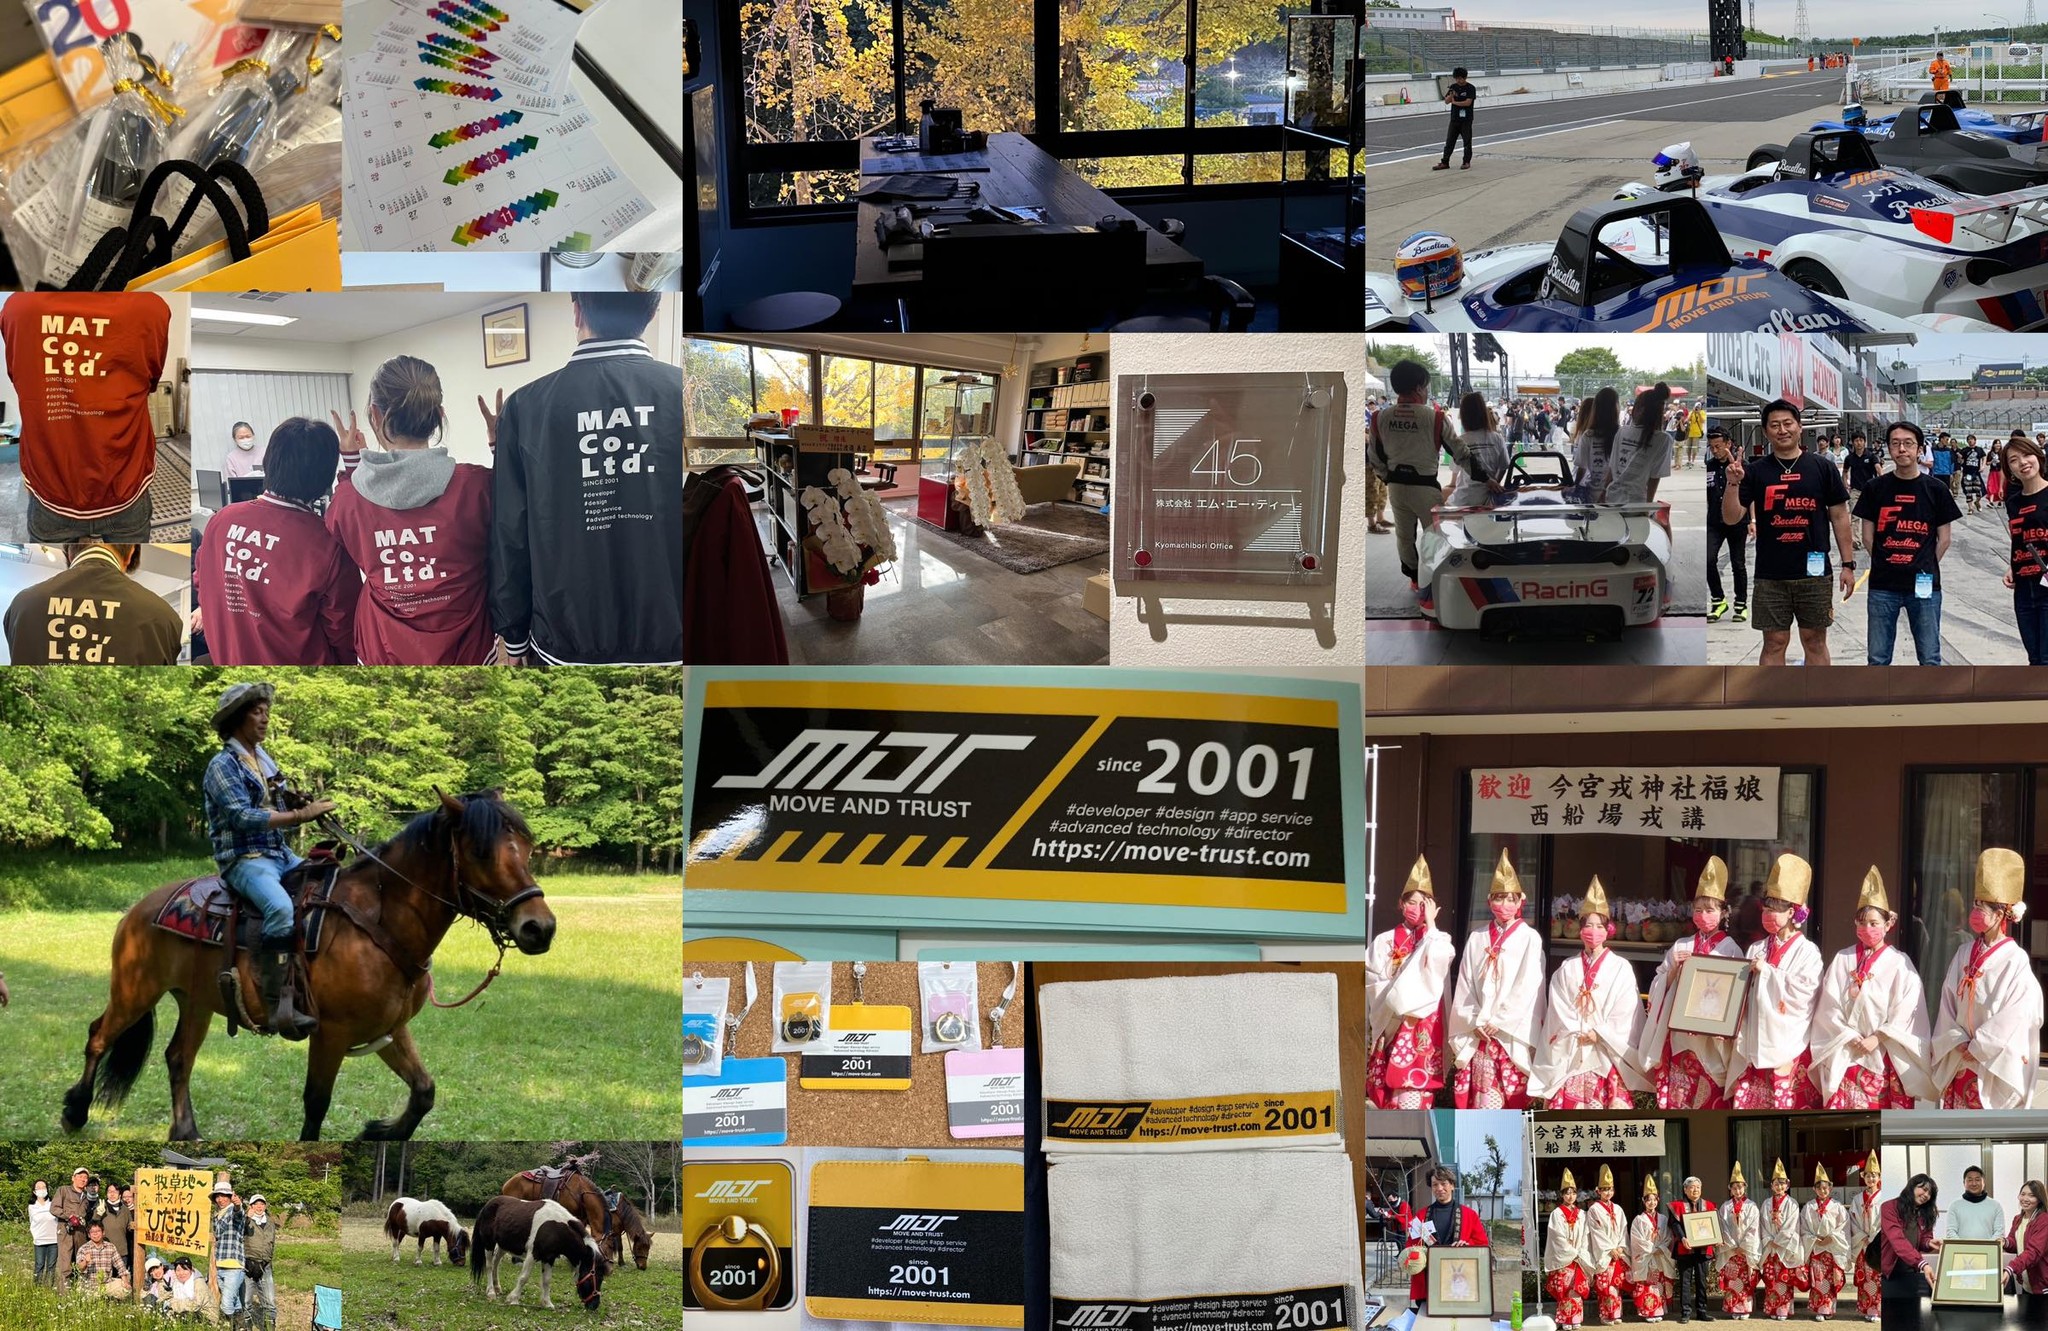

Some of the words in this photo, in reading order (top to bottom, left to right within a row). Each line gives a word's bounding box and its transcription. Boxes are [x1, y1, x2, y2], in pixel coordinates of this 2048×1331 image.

[473, 124, 481, 133] 9
[485, 153, 500, 166] 10
[506, 170, 515, 178] 30
[566, 180, 576, 189] 12
[408, 209, 417, 218] 27
[501, 210, 514, 223] 11
[373, 223, 383, 231] 26
[499, 233, 507, 242] 27
[1412, 241, 1450, 257] Bacallan
[1548, 255, 1581, 294] Bacallan
[1668, 303, 1708, 330] MOVE
[1709, 297, 1735, 313] AND
[1735, 291, 1773, 305] TRUST
[41, 315, 110, 337] MAT
[42, 336, 103, 360] Co.,
[44, 357, 107, 377] Ltd.
[1781, 338, 1801, 397] NGK
[1812, 354, 1839, 409] HONDA
[577, 405, 655, 432] MAT
[1388, 419, 1418, 431] MEGA
[579, 433, 649, 455] Co.,
[581, 453, 655, 478] Ltd.
[1191, 438, 1262, 486] 45
[582, 479, 604, 487] SINCE
[605, 477, 619, 485] 2001
[583, 490, 616, 498] #developer
[1156, 499, 1192, 508] 株式会社
[1196, 499, 1293, 510] エム・エー・ティー
[1785, 497, 1816, 508] MEGA
[586, 514, 616, 523] #advanced
[1896, 520, 1929, 531] MEGA
[226, 523, 280, 551] MAT
[374, 525, 437, 549] MAT
[1154, 541, 1208, 550] Kyomachibori
[1209, 542, 1234, 550] Office
[379, 549, 436, 566] Co.,
[224, 557, 271, 585] Ltd.
[383, 562, 447, 584] Ltd.
[1521, 579, 1608, 600] RacinG
[47, 597, 121, 620] MAT
[47, 617, 112, 645] Co.,
[48, 640, 116, 663] Ltd.
[1096, 757, 1142, 772] since
[1136, 738, 1314, 801] 2001
[1477, 774, 1533, 799] 歓迎
[1548, 773, 1763, 801] 今宮戎神社福娘
[769, 795, 835, 814] MOVE
[840, 799, 890, 816] AND
[896, 799, 972, 818] TRUST
[1066, 803, 1152, 819] #developer
[1155, 805, 1215, 822] #design
[1219, 808, 1258, 825] #app
[1261, 812, 1313, 825] service
[1530, 802, 1706, 831] 西船場戎講
[1048, 820, 1133, 836] #advanced
[1136, 822, 1221, 840] technology
[1224, 825, 1294, 842] #director
[1031, 837, 1311, 868] https://move-trust.com
[841, 1060, 872, 1070] 2001
[990, 1103, 1020, 1115] 2001
[1150, 1106, 1187, 1116] #developer
[1188, 1105, 1215, 1115] #design
[1216, 1103, 1234, 1113] #app
[1235, 1101, 1260, 1110] service
[1263, 1099, 1284, 1107] since
[715, 1115, 746, 1127] 2001
[1145, 1115, 1182, 1124] #advanced
[1183, 1113, 1219, 1123] technology
[1221, 1111, 1253, 1120] #director
[1264, 1105, 1331, 1131] 2001
[1069, 1128, 1089, 1136] MOVE
[1105, 1128, 1128, 1136] TRUST
[1139, 1122, 1261, 1138] https://move-trust.com
[1534, 1124, 1657, 1140] 今宮戎神社福娘
[1537, 1140, 1627, 1154] 船場戎講
[155, 1191, 193, 1205] ホースパーク
[146, 1207, 199, 1239] ひだまり
[871, 1237, 903, 1245] #developer
[709, 1270, 756, 1286] 2001
[889, 1265, 949, 1286] 2001
[868, 1286, 971, 1299] https://move-trust.com
[1274, 1294, 1294, 1304] since
[1152, 1303, 1191, 1313] #developer
[1193, 1301, 1220, 1310] #design
[1221, 1300, 1240, 1309] #app
[1241, 1299, 1267, 1308] service
[1192, 1310, 1231, 1319] technology
[1232, 1309, 1266, 1318] #director
[1275, 1298, 1343, 1330] 2001
